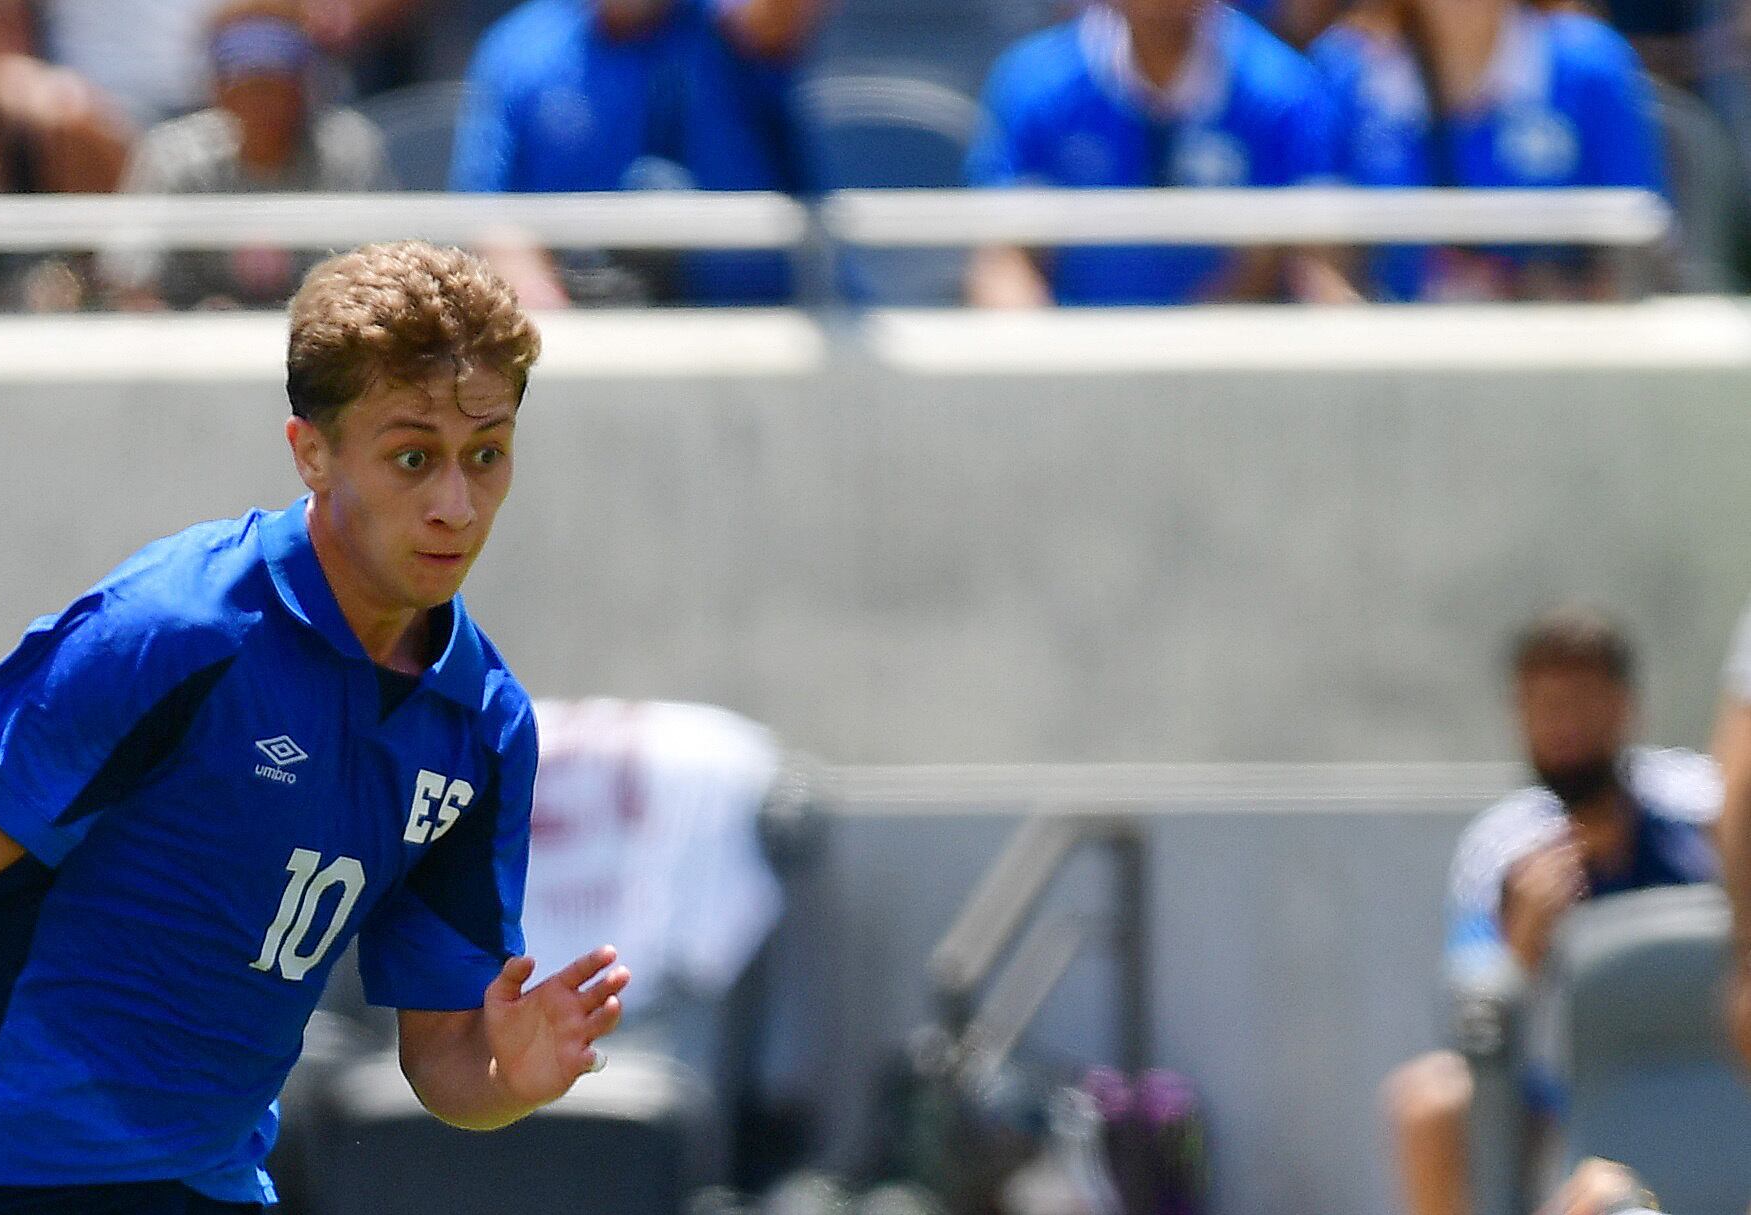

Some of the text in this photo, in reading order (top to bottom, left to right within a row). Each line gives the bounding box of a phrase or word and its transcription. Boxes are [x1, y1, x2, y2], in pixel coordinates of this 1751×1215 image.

[255, 763, 297, 784] umbro
[403, 768, 475, 844] ES
[248, 847, 366, 981] 10
